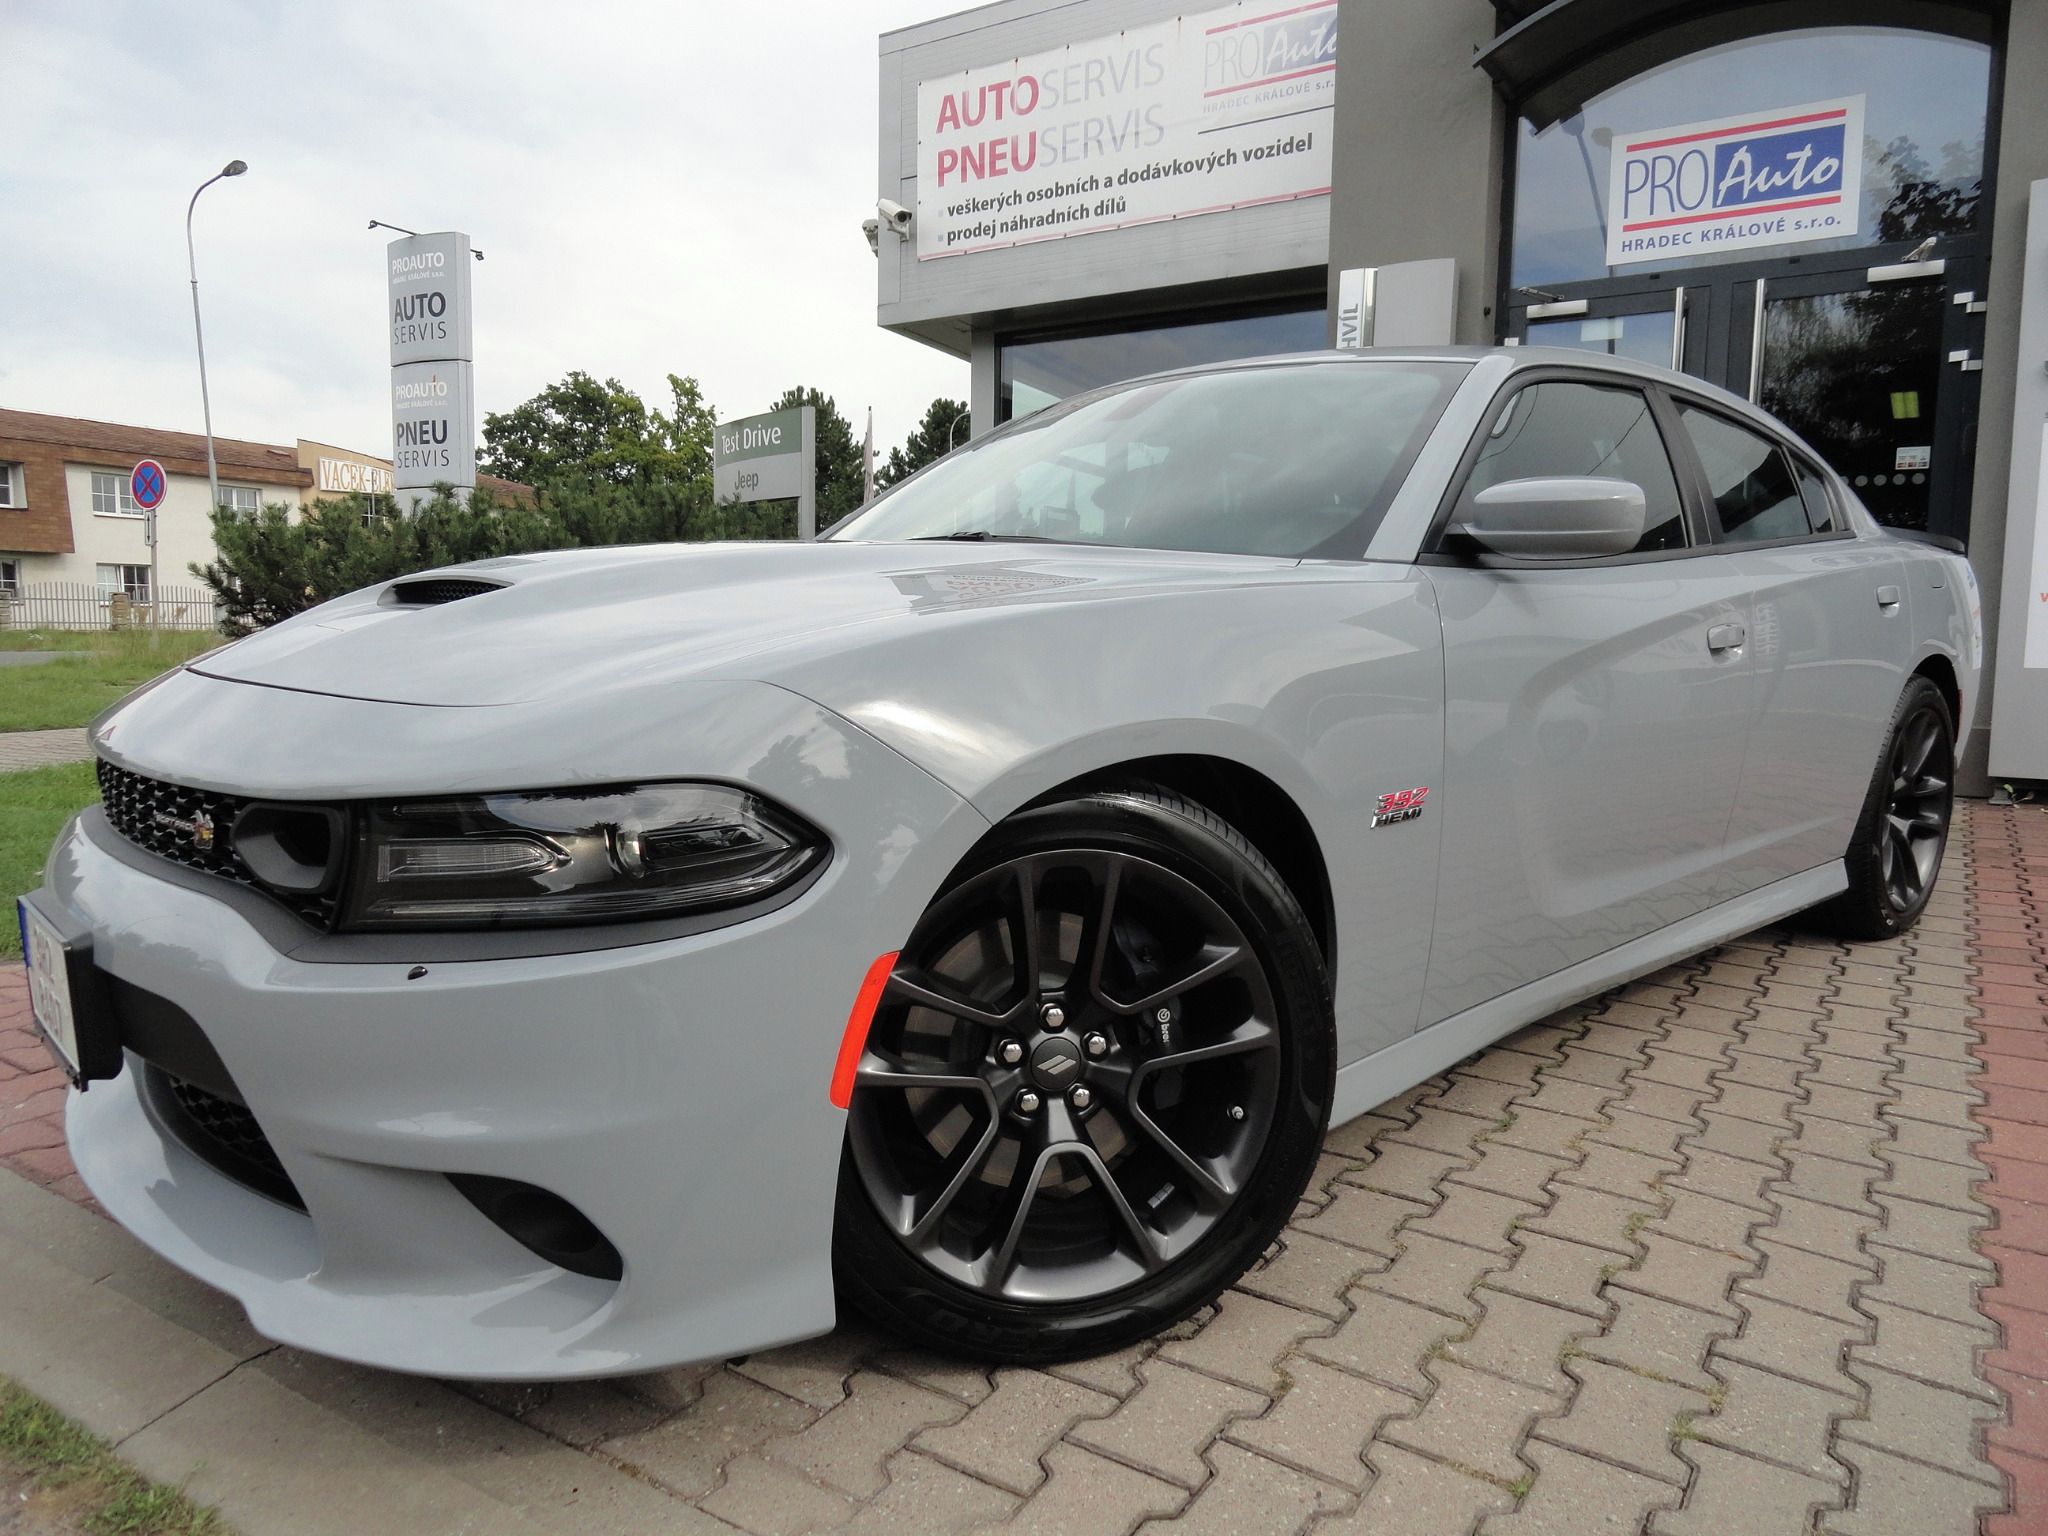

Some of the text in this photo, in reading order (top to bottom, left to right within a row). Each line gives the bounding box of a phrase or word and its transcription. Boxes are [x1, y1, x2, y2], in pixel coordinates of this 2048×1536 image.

[936, 43, 1164, 134] AUTOSERVIS
[1203, 94, 1249, 114] HRADEC
[1255, 80, 1310, 104] KRÁLOVÉ
[937, 103, 1164, 188] PNEUSERVIS
[947, 132, 1312, 217] veškerých osobních a dodávkových vozidel
[947, 195, 1126, 246] prodej náhradních dílů
[1621, 215, 1842, 253] HRADEC KRÁLOVÉ s.r.o.
[392, 252, 445, 275] PROAUTO
[394, 291, 446, 323] AUTO
[394, 321, 447, 346] SERVIS
[395, 381, 448, 401] PROAUTO
[396, 419, 448, 447] PNEU
[721, 425, 781, 455] Test Drive
[397, 449, 450, 469] SERVIS
[734, 470, 759, 491] Jeep
[1375, 787, 1430, 815] 392
[1370, 807, 1422, 829] HEMI
